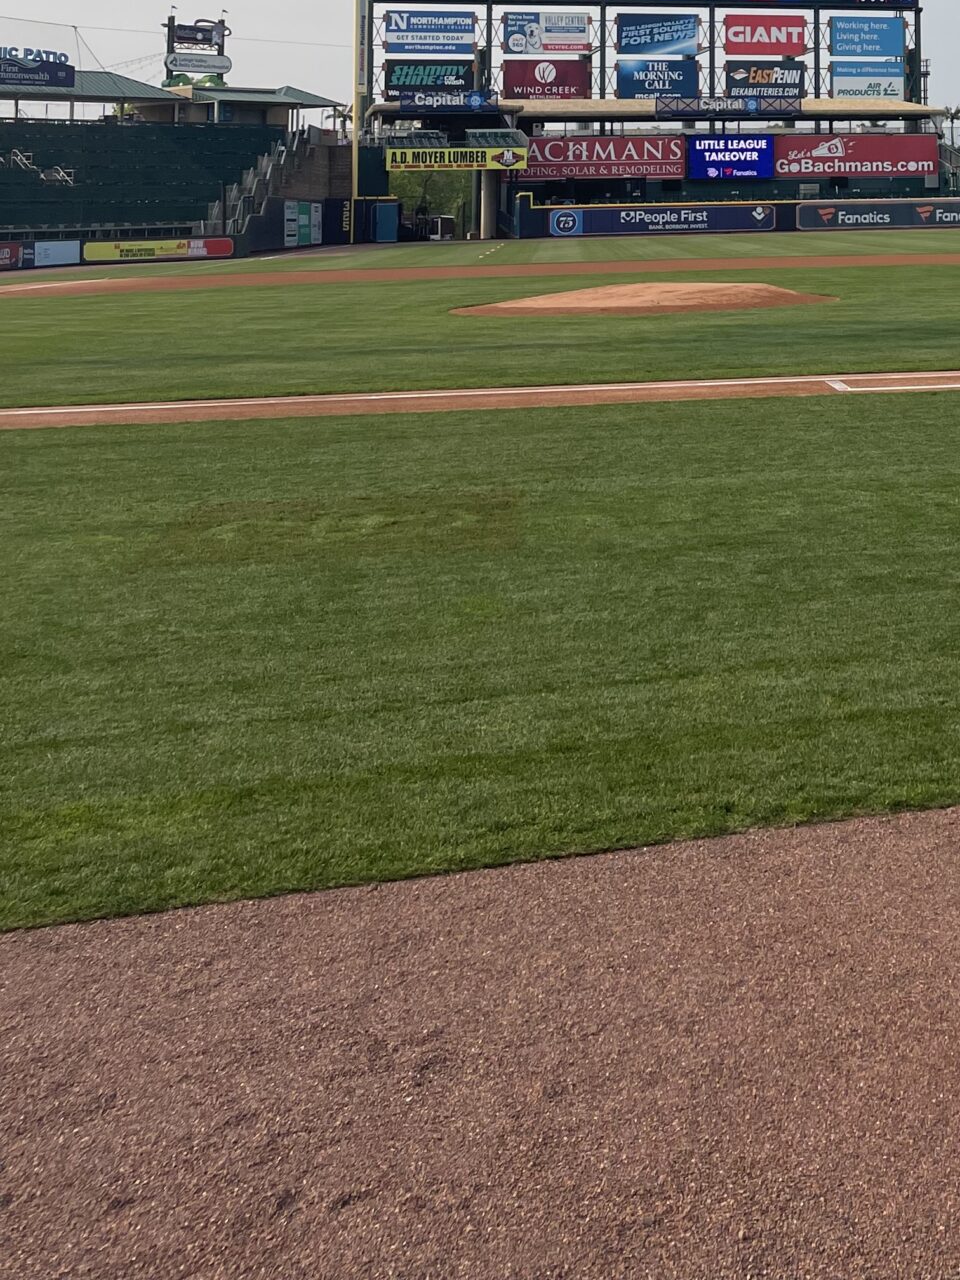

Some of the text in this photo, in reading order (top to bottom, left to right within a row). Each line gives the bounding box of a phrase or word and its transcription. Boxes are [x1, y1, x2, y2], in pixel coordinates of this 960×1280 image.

[410, 17, 472, 25] NORTHAMPTON
[836, 22, 869, 31] Working
[621, 23, 695, 38] FIRST SOURCE
[727, 26, 803, 43] GIANT
[621, 29, 696, 47] FOR NEWS
[836, 33, 860, 41] Living
[836, 43, 882, 52] Giving here.
[0, 46, 69, 64] IC PATIO
[393, 65, 468, 76] SHAMMY
[646, 62, 669, 71] THE
[389, 75, 438, 85] SHINE
[633, 71, 684, 81] MORNING
[513, 86, 577, 94] WIND CREEK
[645, 80, 672, 89] CALL
[730, 87, 800, 96] DEKABATTERIES.COM
[414, 93, 464, 108] Capital
[700, 99, 742, 111] Capital
[696, 139, 767, 149] LITTLE LEAGUE
[529, 139, 682, 161] ACHMAN'S
[787, 149, 811, 159] Let's
[391, 150, 487, 164] A.D. MOYER LUMBER
[704, 151, 759, 161] TAKEOVER
[562, 166, 596, 175] SOLAR
[600, 165, 608, 174] &
[611, 164, 682, 174] REMODELING
[775, 159, 934, 173] GoBachmans.com
[559, 216, 574, 228] 75
[636, 210, 708, 225] People First
[838, 211, 891, 224] Fanatics
